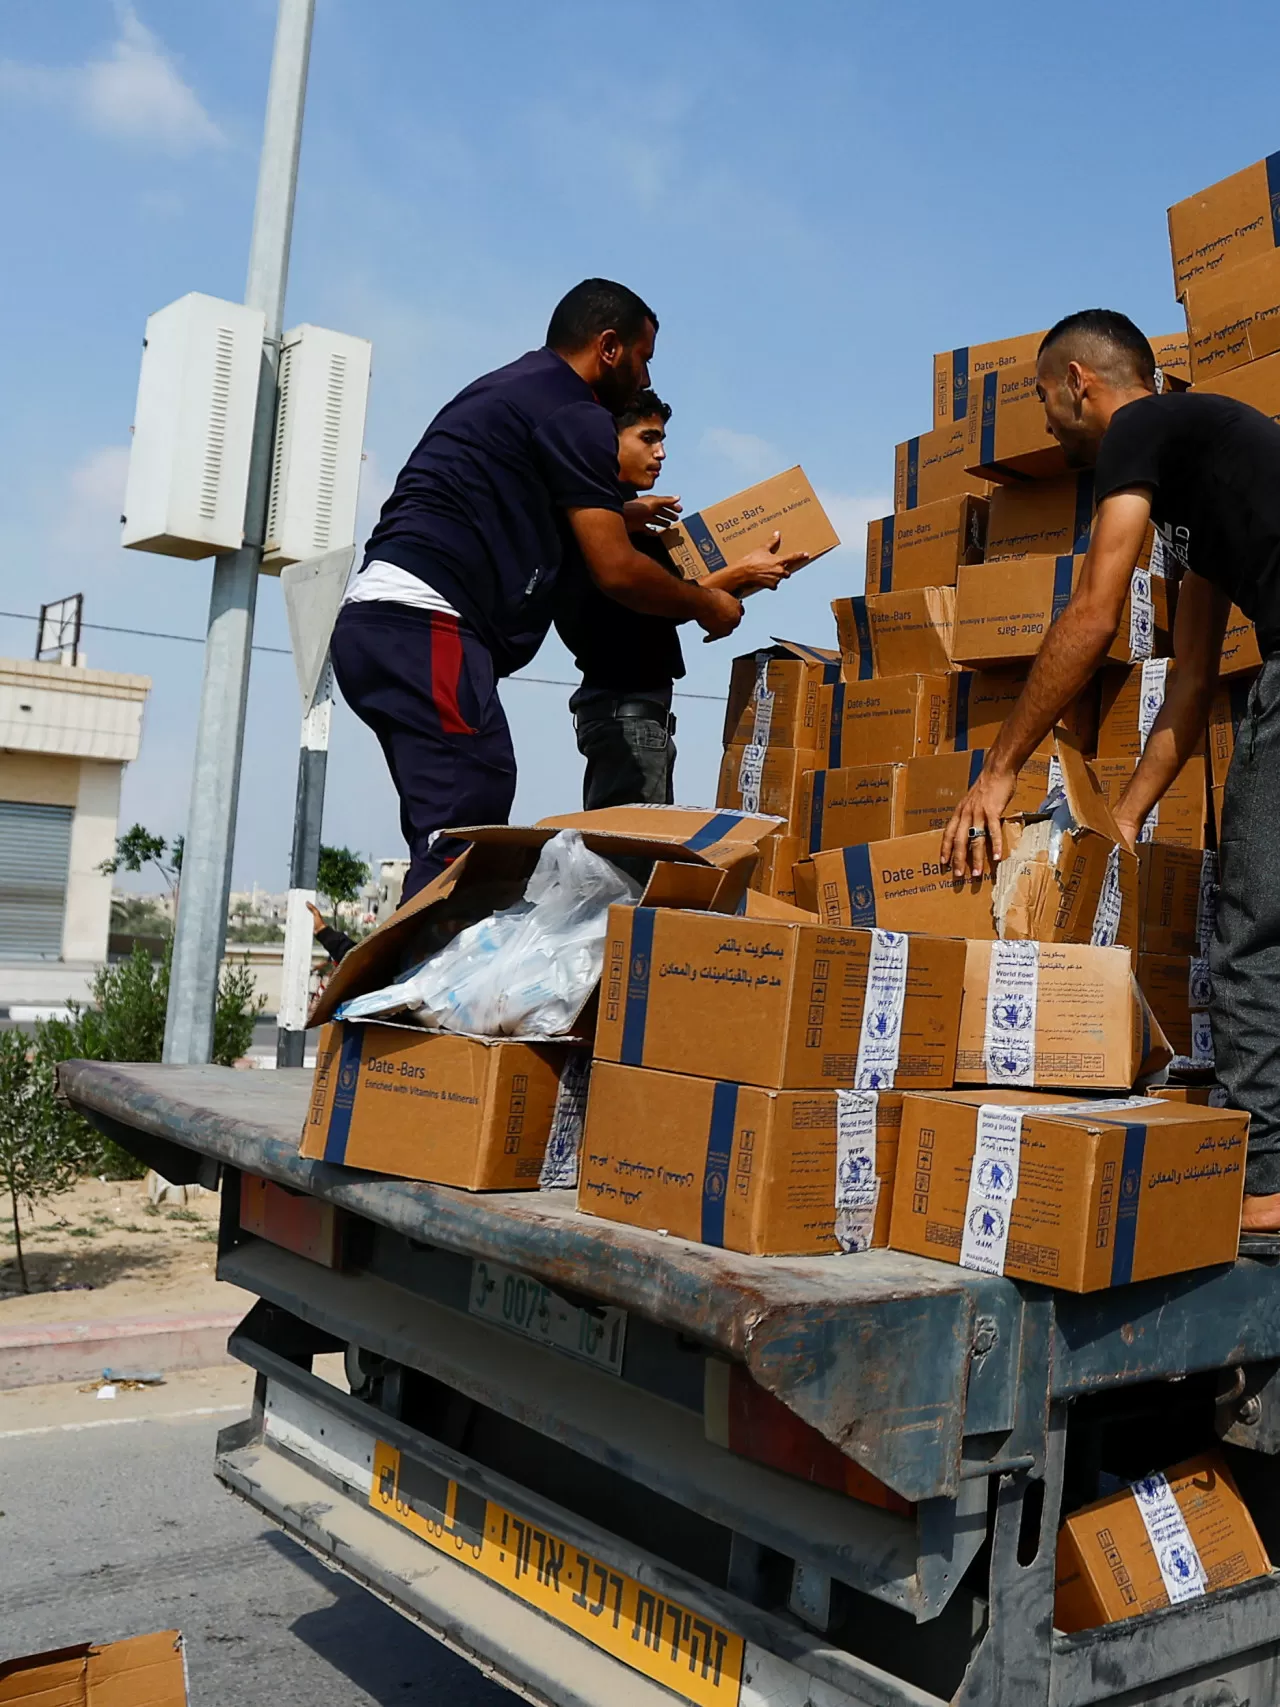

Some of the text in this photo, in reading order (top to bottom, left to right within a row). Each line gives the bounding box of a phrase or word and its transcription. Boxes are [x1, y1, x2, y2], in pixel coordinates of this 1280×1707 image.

[975, 361, 994, 372] Date
[1002, 376, 1037, 393] Date -Bar
[715, 504, 765, 533] Date -Bars
[722, 527, 746, 543] Enriched
[747, 523, 758, 532] with
[758, 510, 782, 525] Vitamins
[788, 497, 811, 511] Minerals
[898, 527, 914, 540] Date
[872, 612, 890, 623] Date
[1021, 624, 1043, 634] Date
[847, 699, 863, 709] Date
[882, 869, 914, 884] Date
[884, 887, 918, 900] Enriched
[920, 884, 937, 894] with
[939, 877, 973, 889] Vitamins
[816, 935, 837, 944] Date
[714, 939, 784, 960] بسكويت بالتمر
[1039, 963, 1065, 971] بالفيتامين
[659, 962, 781, 989] مدعم بالفيتامينات والمعادن
[996, 979, 1033, 987] Programme
[367, 1057, 425, 1080] Date -Bars
[364, 1079, 479, 1105] Enriched with Vitamins & Minerals
[840, 1119, 872, 1129] World Food
[983, 1113, 1017, 1123] Programme
[840, 1128, 872, 1137] Programme
[848, 1147, 864, 1155] WFP
[1195, 1134, 1242, 1154] بسكويت بالتمر
[1223, 1162, 1239, 1177] مدعم
[1149, 1169, 1181, 1189] والمعادن
[975, 1240, 992, 1249] WFP
[572, 1553, 624, 1630] רכב
[632, 1588, 728, 1687] זהירות
